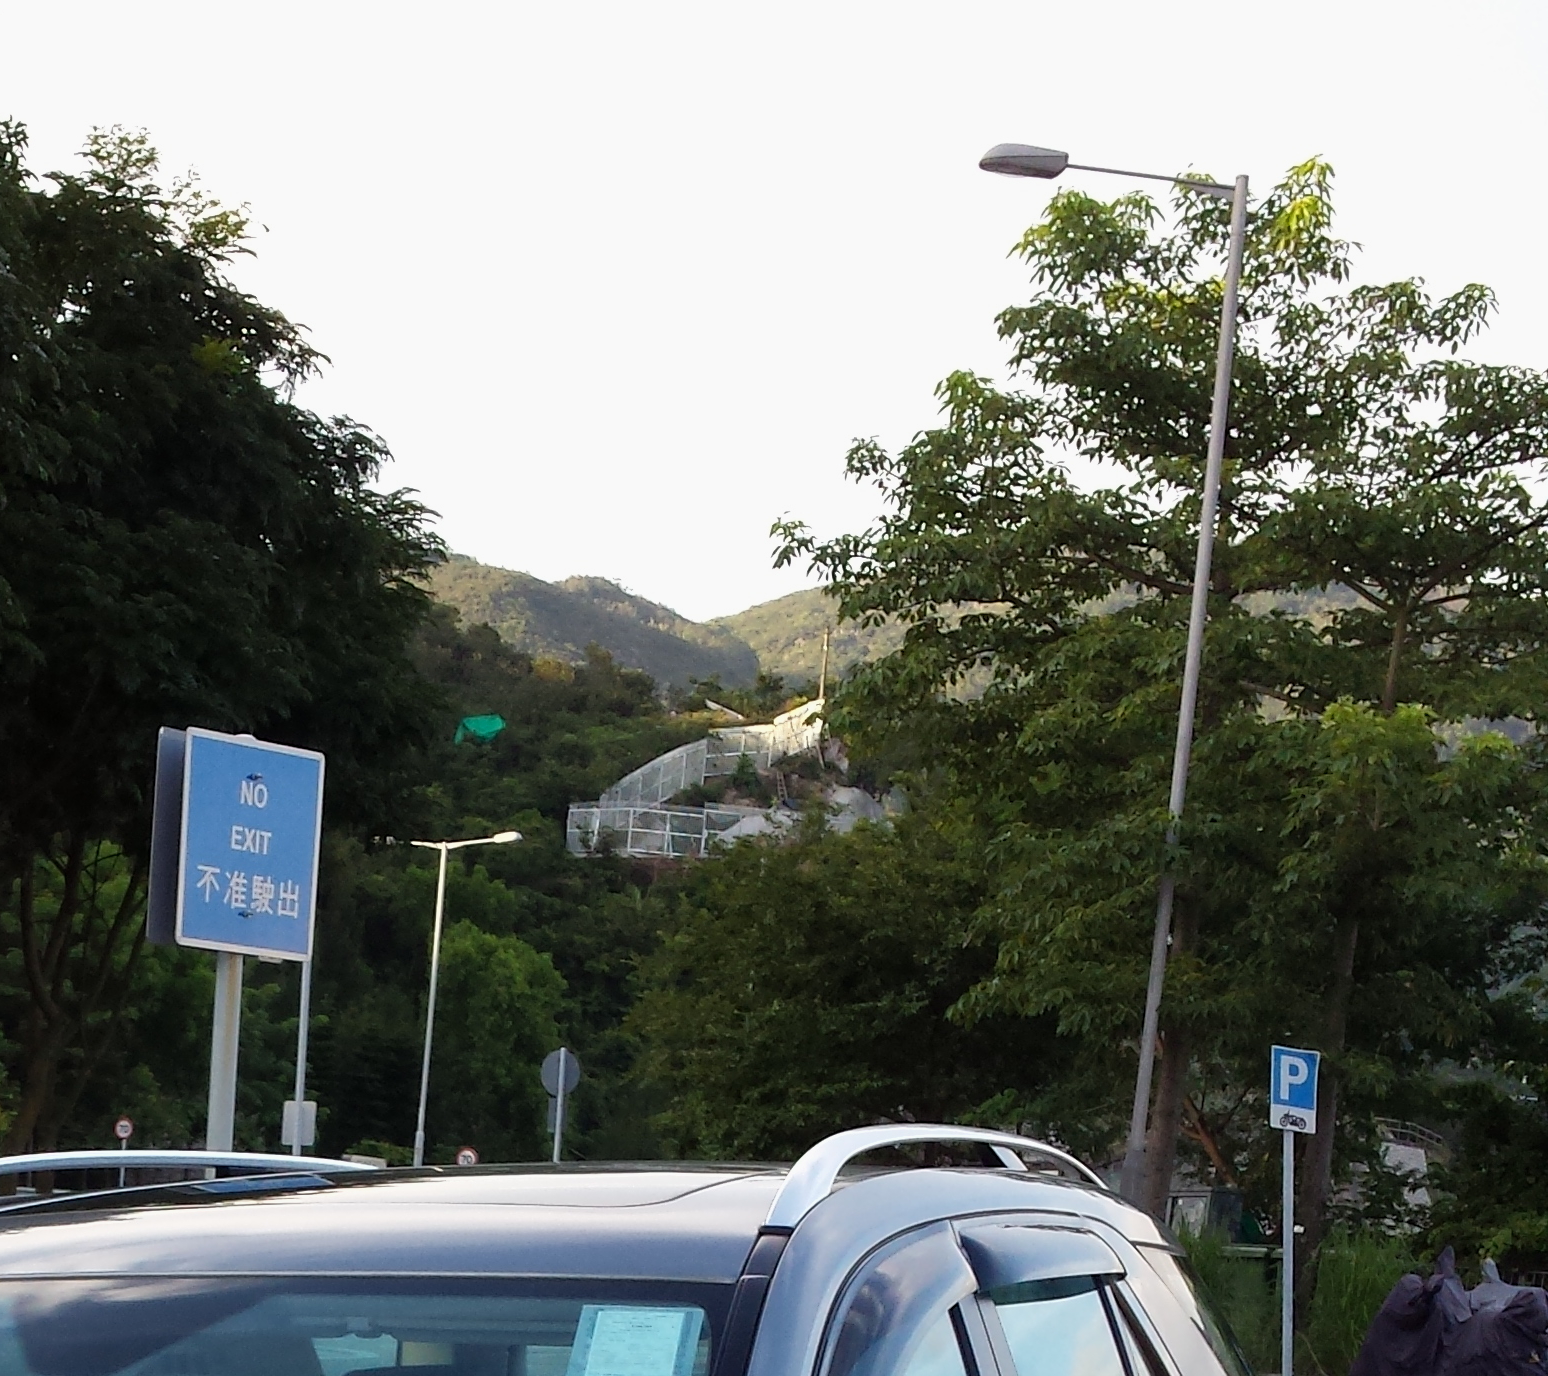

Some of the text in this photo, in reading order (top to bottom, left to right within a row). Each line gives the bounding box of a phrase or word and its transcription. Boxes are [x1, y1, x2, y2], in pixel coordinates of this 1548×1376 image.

[240, 780, 268, 808] NO
[230, 825, 272, 855] EXIT
[196, 865, 300, 919] 不准駛出
[1279, 1054, 1309, 1100] P
